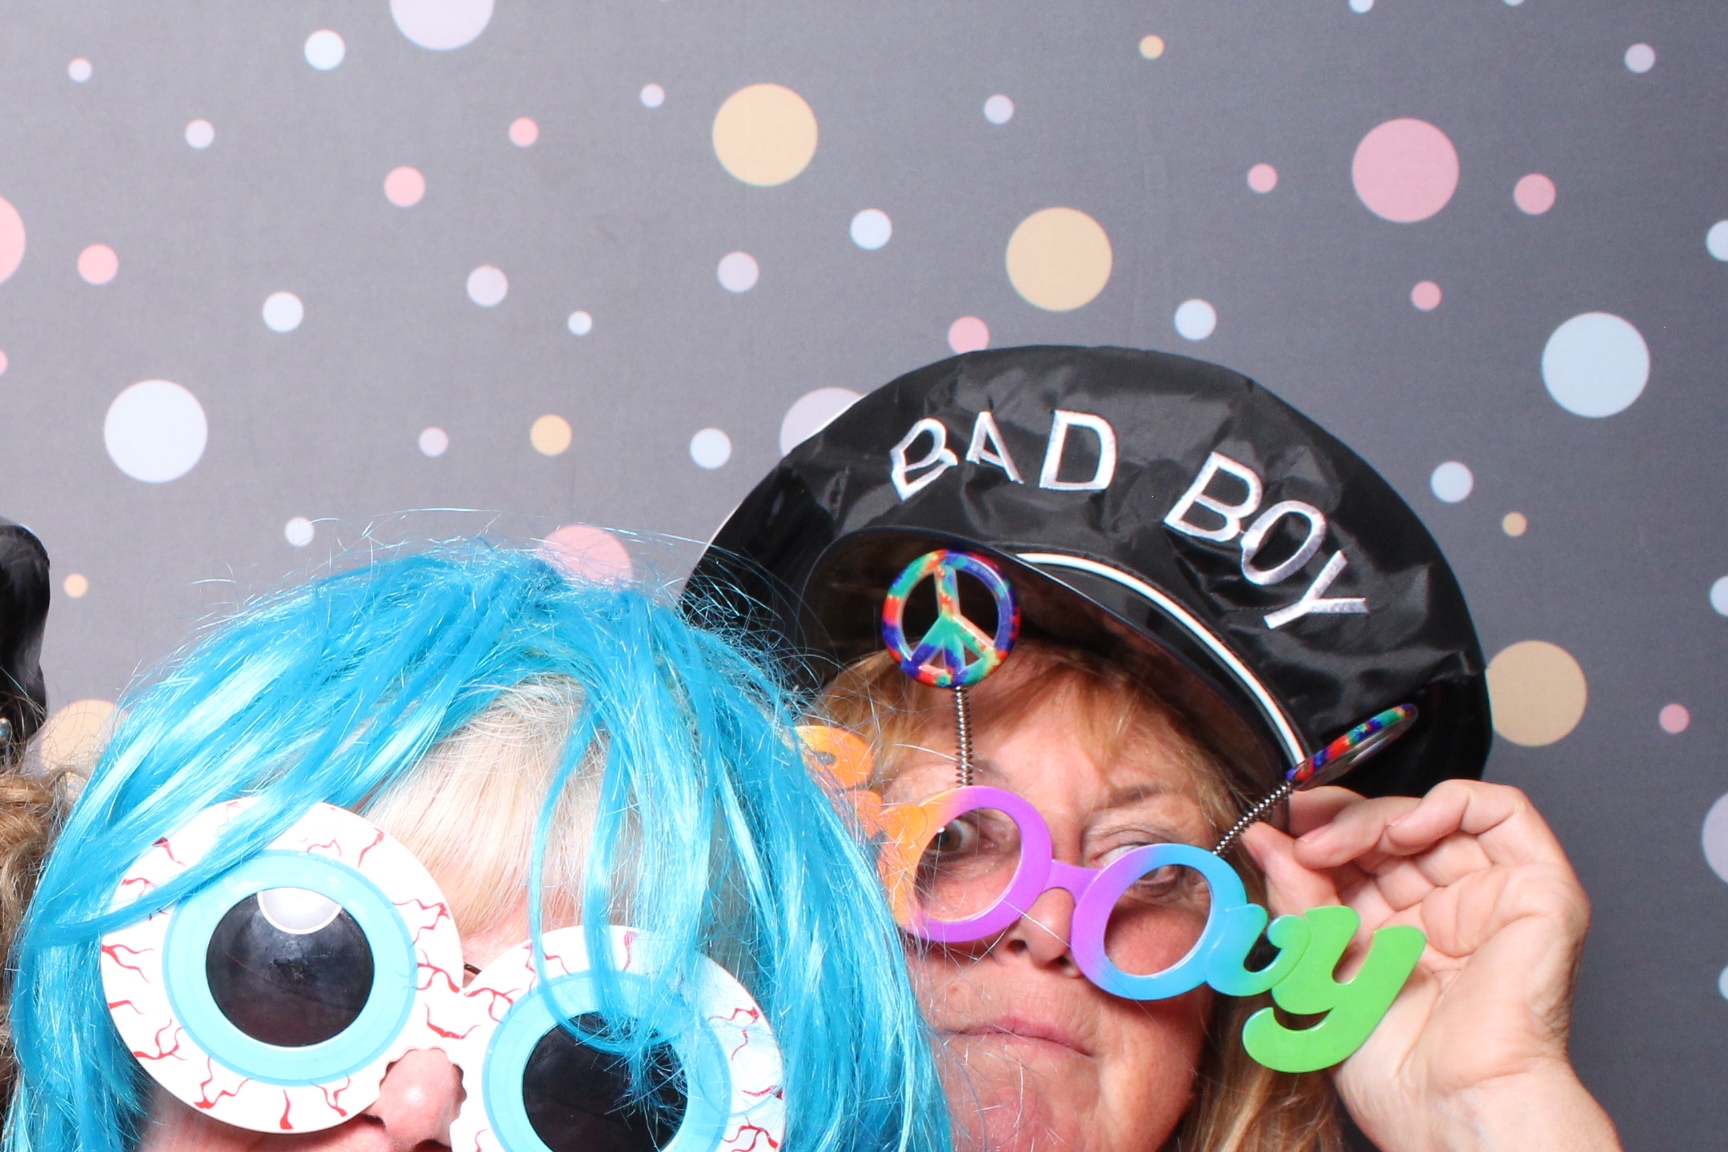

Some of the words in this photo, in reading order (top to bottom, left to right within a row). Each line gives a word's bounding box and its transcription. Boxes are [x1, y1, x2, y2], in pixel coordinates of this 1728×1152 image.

[890, 409, 1118, 501] BAD
[1163, 451, 1370, 630] BOY
[794, 724, 1428, 1074] oovy
